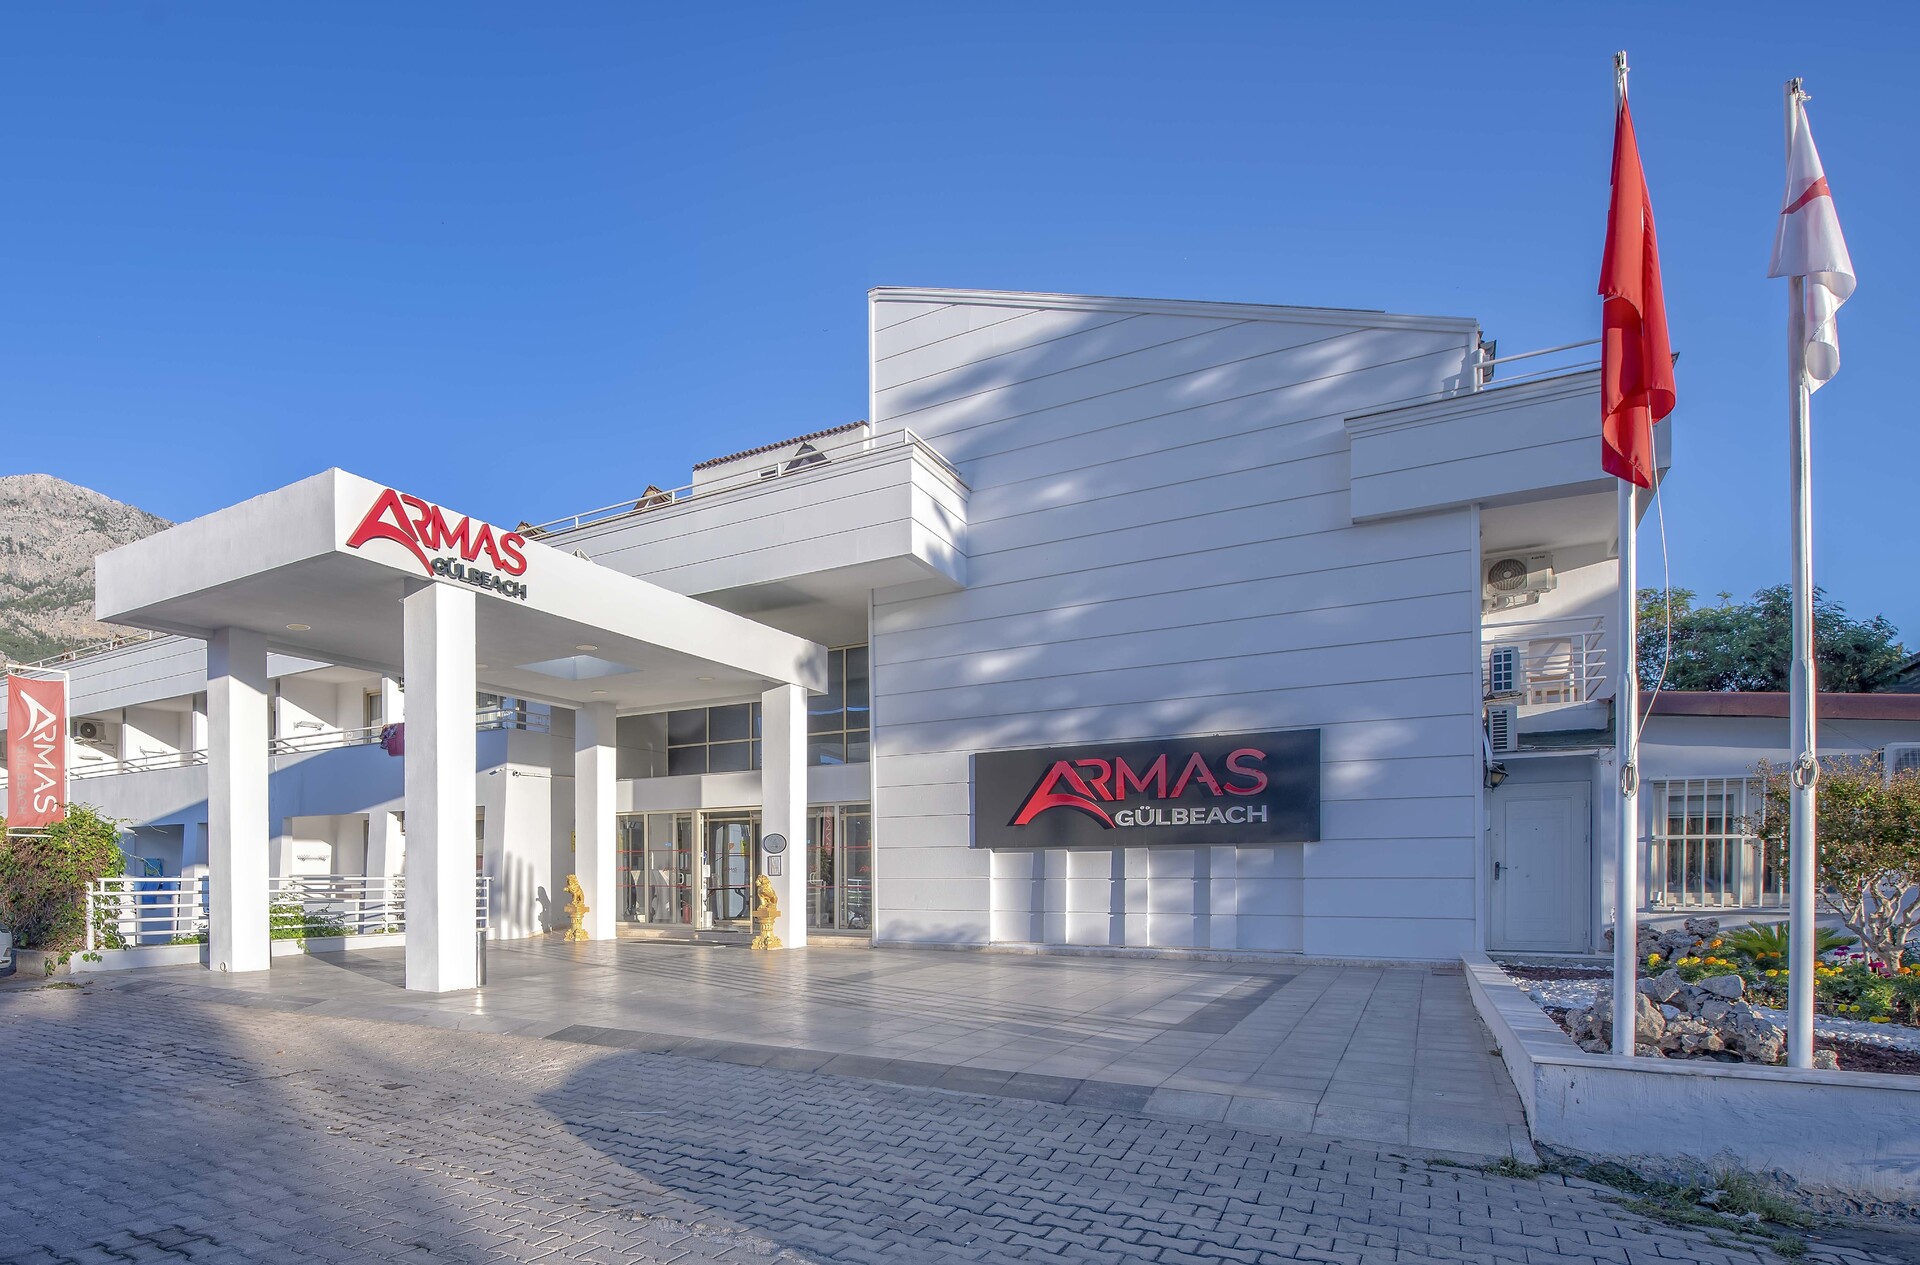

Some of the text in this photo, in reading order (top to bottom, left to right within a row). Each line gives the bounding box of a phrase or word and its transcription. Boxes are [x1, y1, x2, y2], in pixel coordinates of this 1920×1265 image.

[346, 488, 527, 577] ARMAS
[430, 558, 527, 600] GÜLBEACH
[18, 690, 57, 813] ARMAS
[1013, 748, 1268, 828] ARMAS
[1115, 805, 1268, 826] GÜLBEACH
